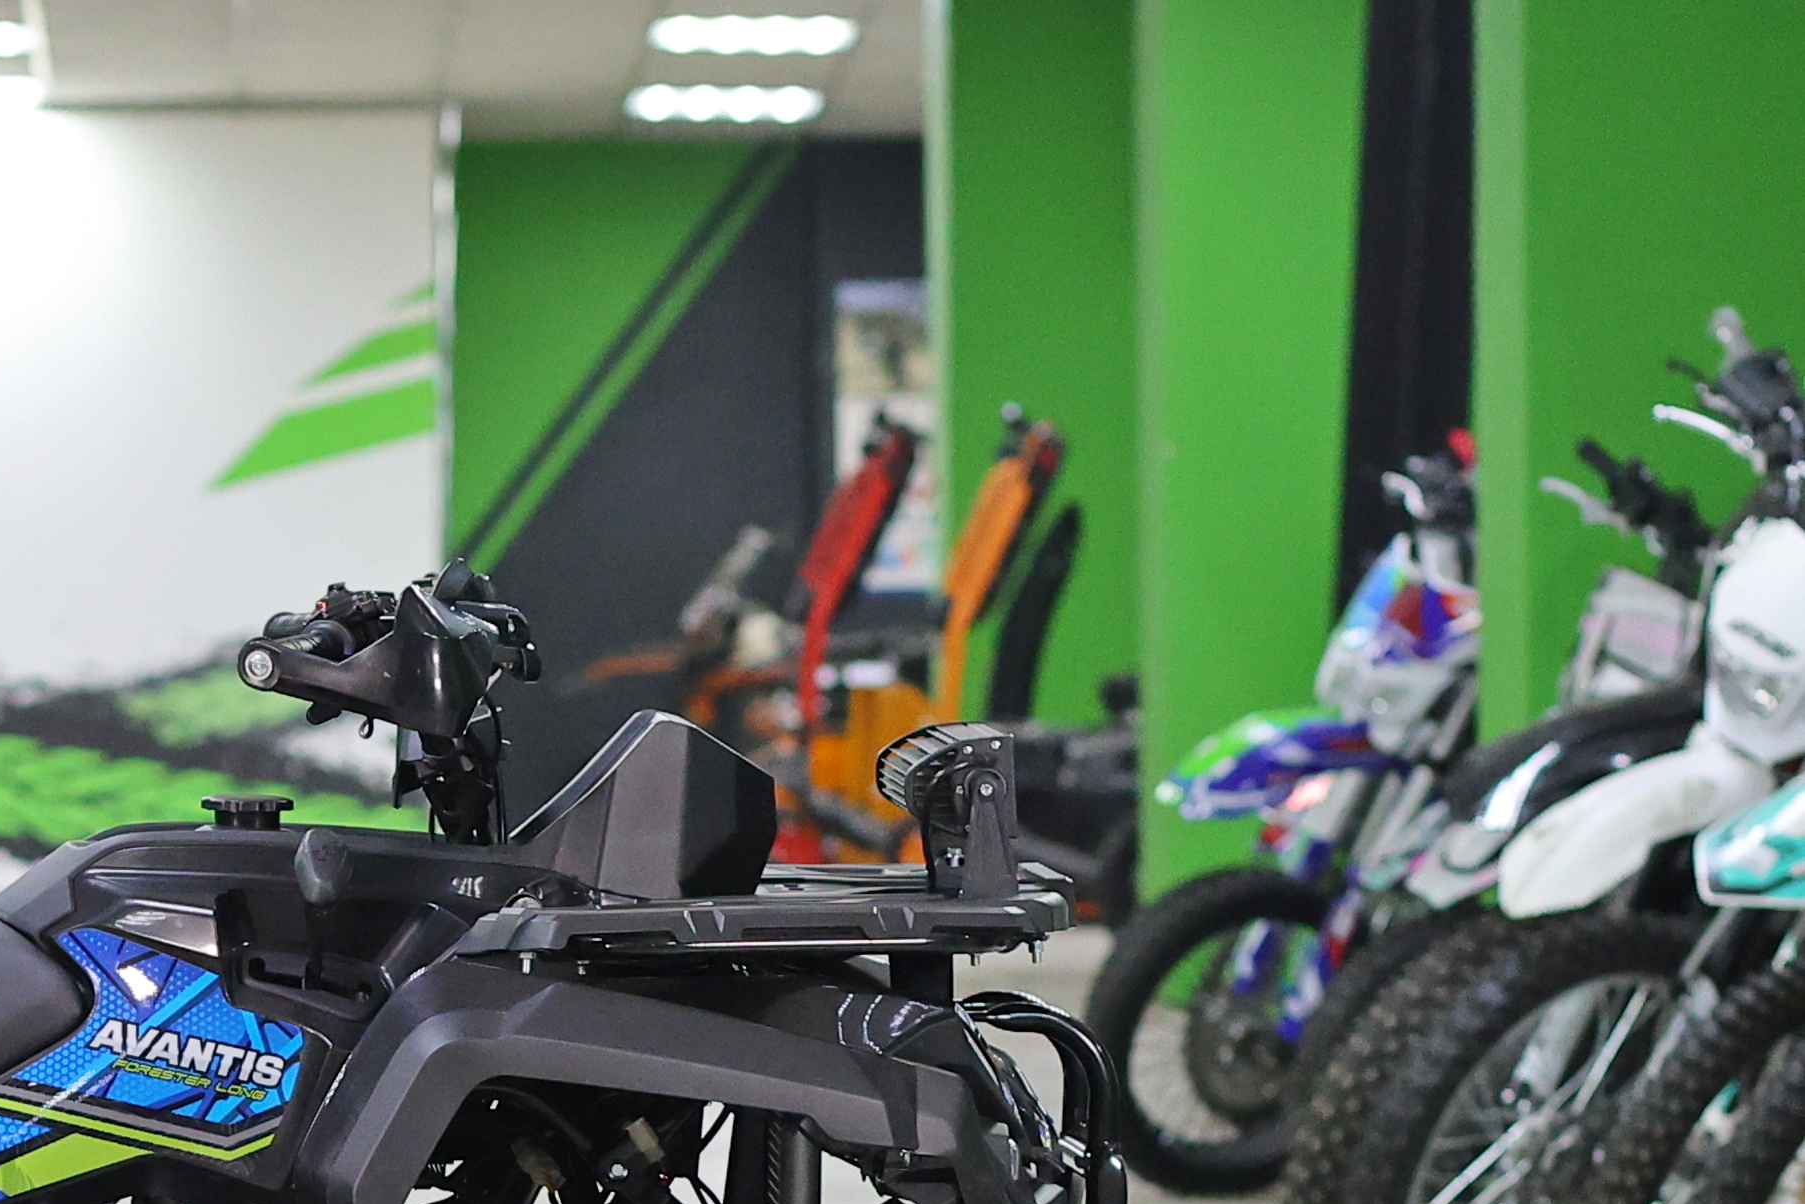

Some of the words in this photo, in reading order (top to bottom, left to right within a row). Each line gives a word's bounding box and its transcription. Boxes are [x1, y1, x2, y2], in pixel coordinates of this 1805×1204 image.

[89, 1019, 285, 1087] AVANTIS
[112, 1059, 212, 1088] FORESTER
[215, 1082, 268, 1101] LONG
